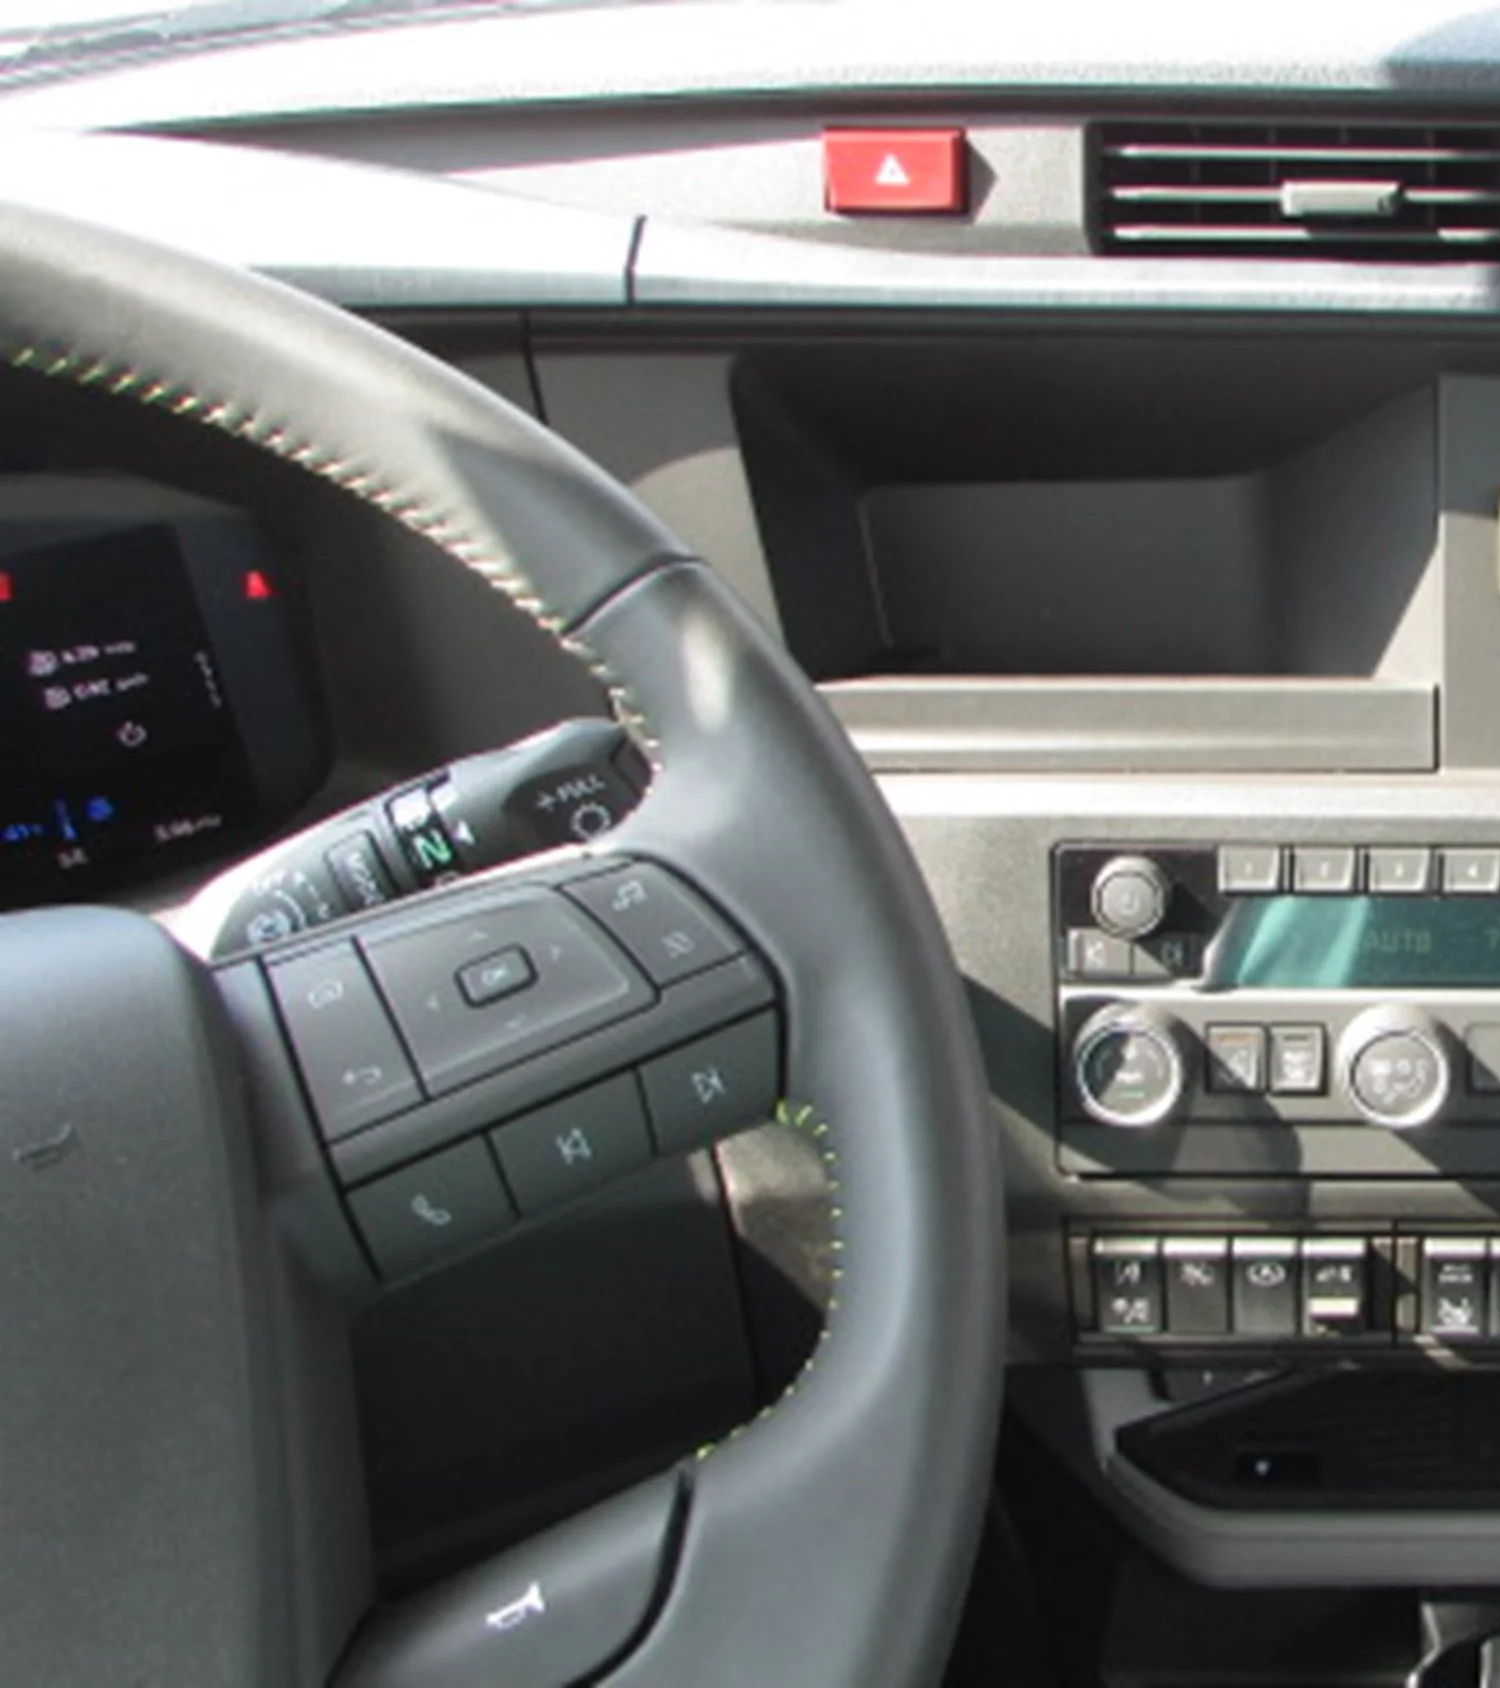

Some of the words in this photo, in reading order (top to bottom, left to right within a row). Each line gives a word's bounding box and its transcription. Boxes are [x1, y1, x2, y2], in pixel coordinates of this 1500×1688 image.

[556, 774, 606, 802] PULL
[413, 830, 454, 868] N
[1364, 929, 1433, 955] AUTO
